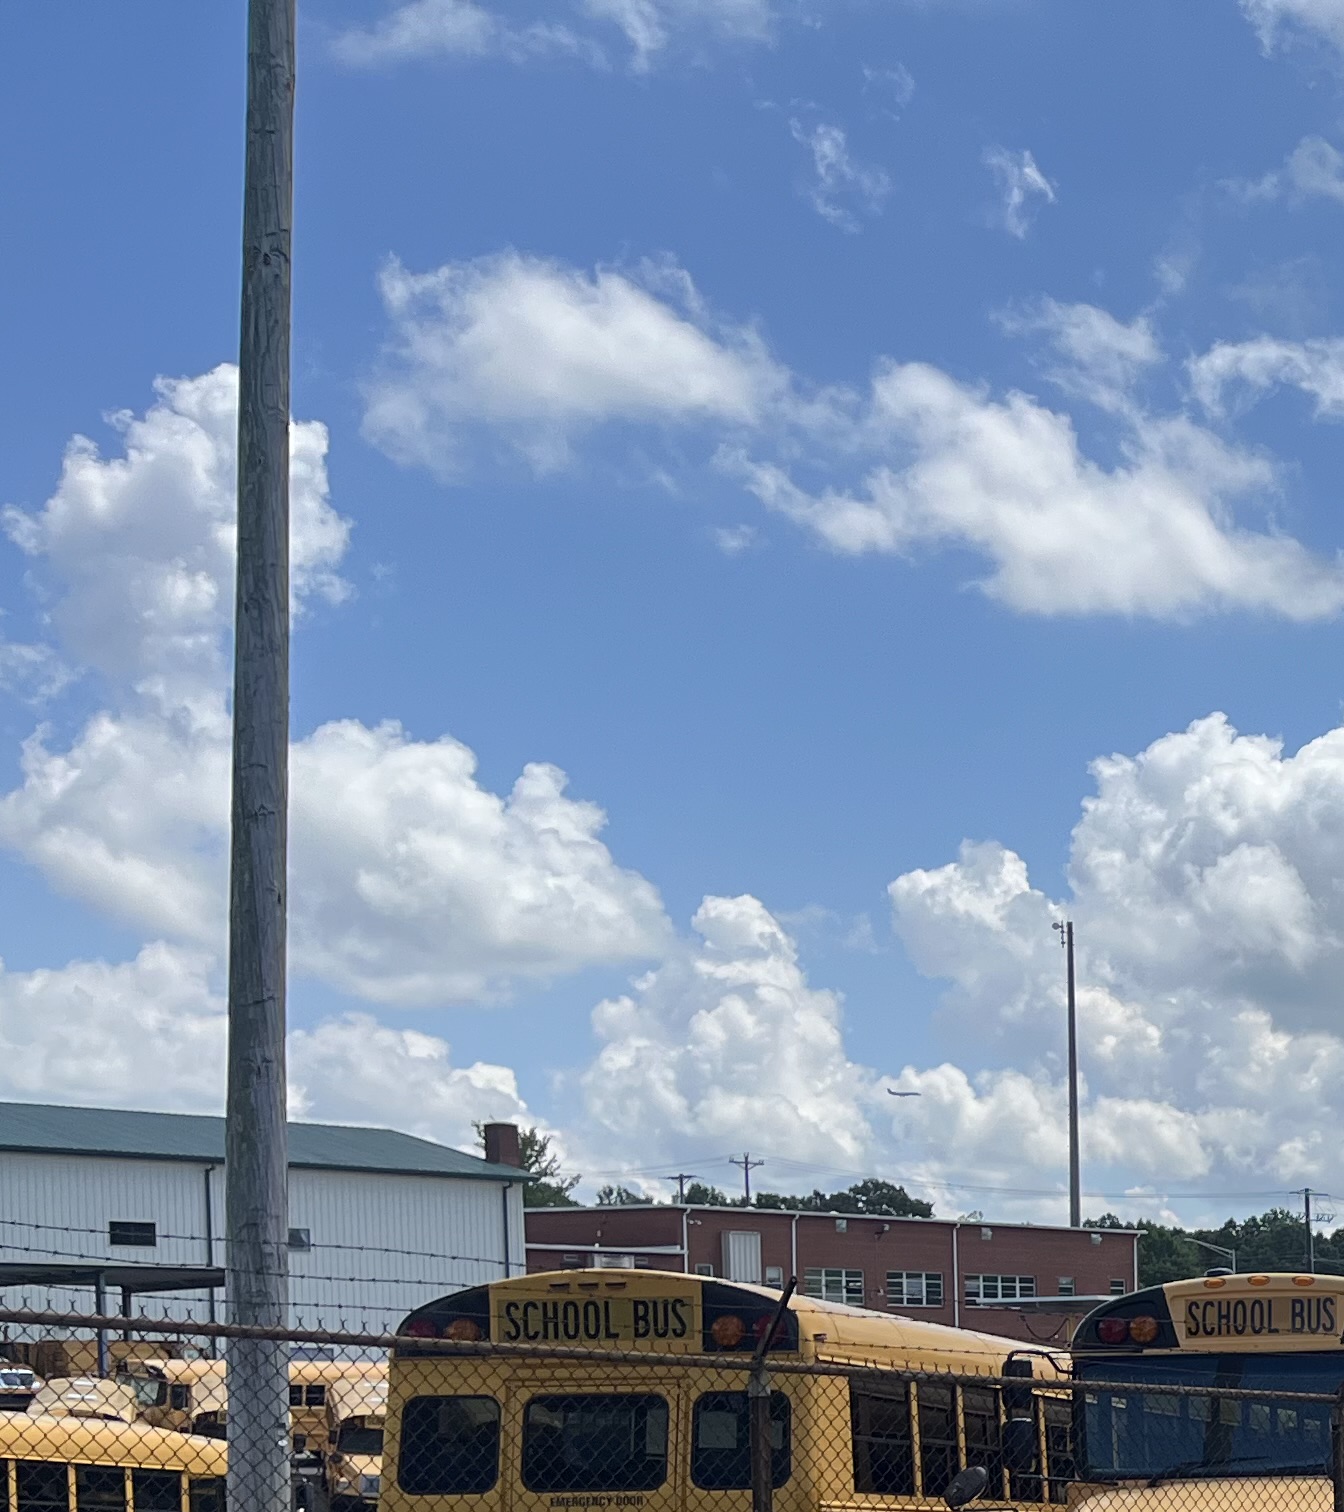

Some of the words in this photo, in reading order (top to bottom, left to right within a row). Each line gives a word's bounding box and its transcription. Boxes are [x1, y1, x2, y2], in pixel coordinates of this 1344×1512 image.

[505, 1301, 620, 1341] SCHOOL
[633, 1298, 688, 1339] BUS
[1188, 1299, 1280, 1336] SCHOOL
[1291, 1296, 1336, 1333] BUS
[550, 1496, 613, 1507] EMERGENCY
[615, 1495, 644, 1506] DOOR
